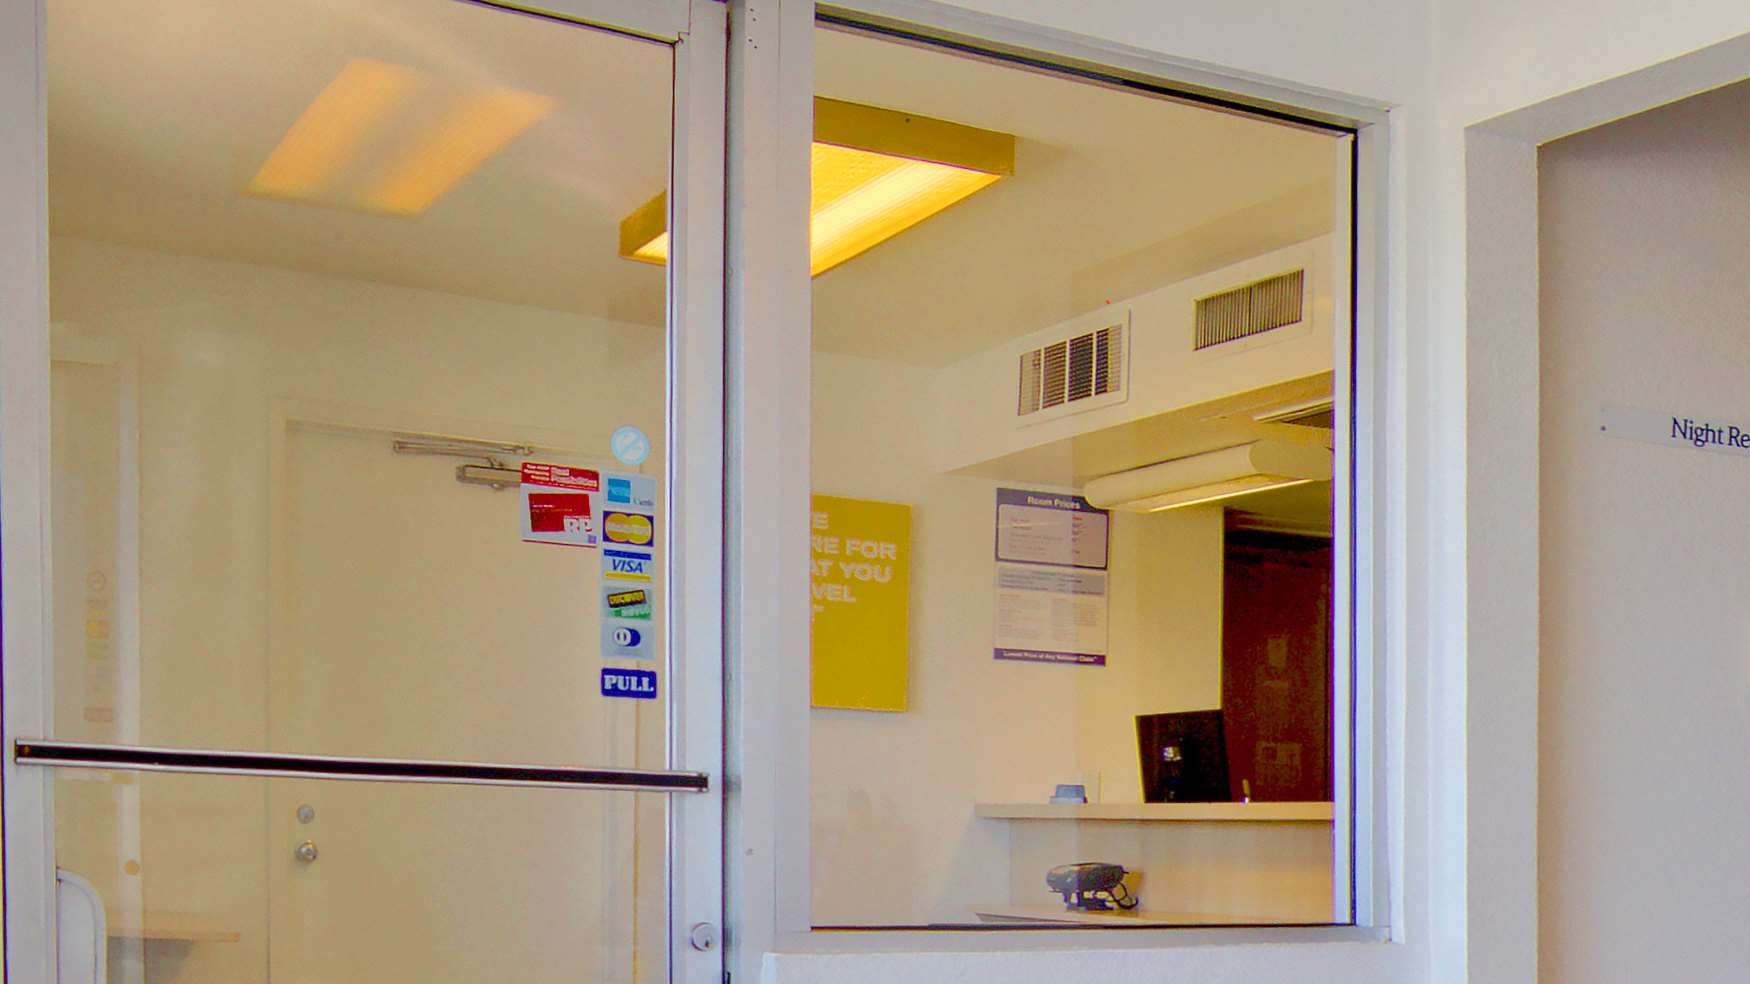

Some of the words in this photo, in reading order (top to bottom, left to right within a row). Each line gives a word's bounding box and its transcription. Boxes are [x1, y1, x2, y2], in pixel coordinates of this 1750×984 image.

[1671, 416, 1724, 447] Night
[812, 536, 839, 554] RE
[846, 537, 897, 560] FOR
[612, 558, 643, 573] VISA
[839, 561, 891, 582] YOU
[603, 675, 654, 692] PULL
